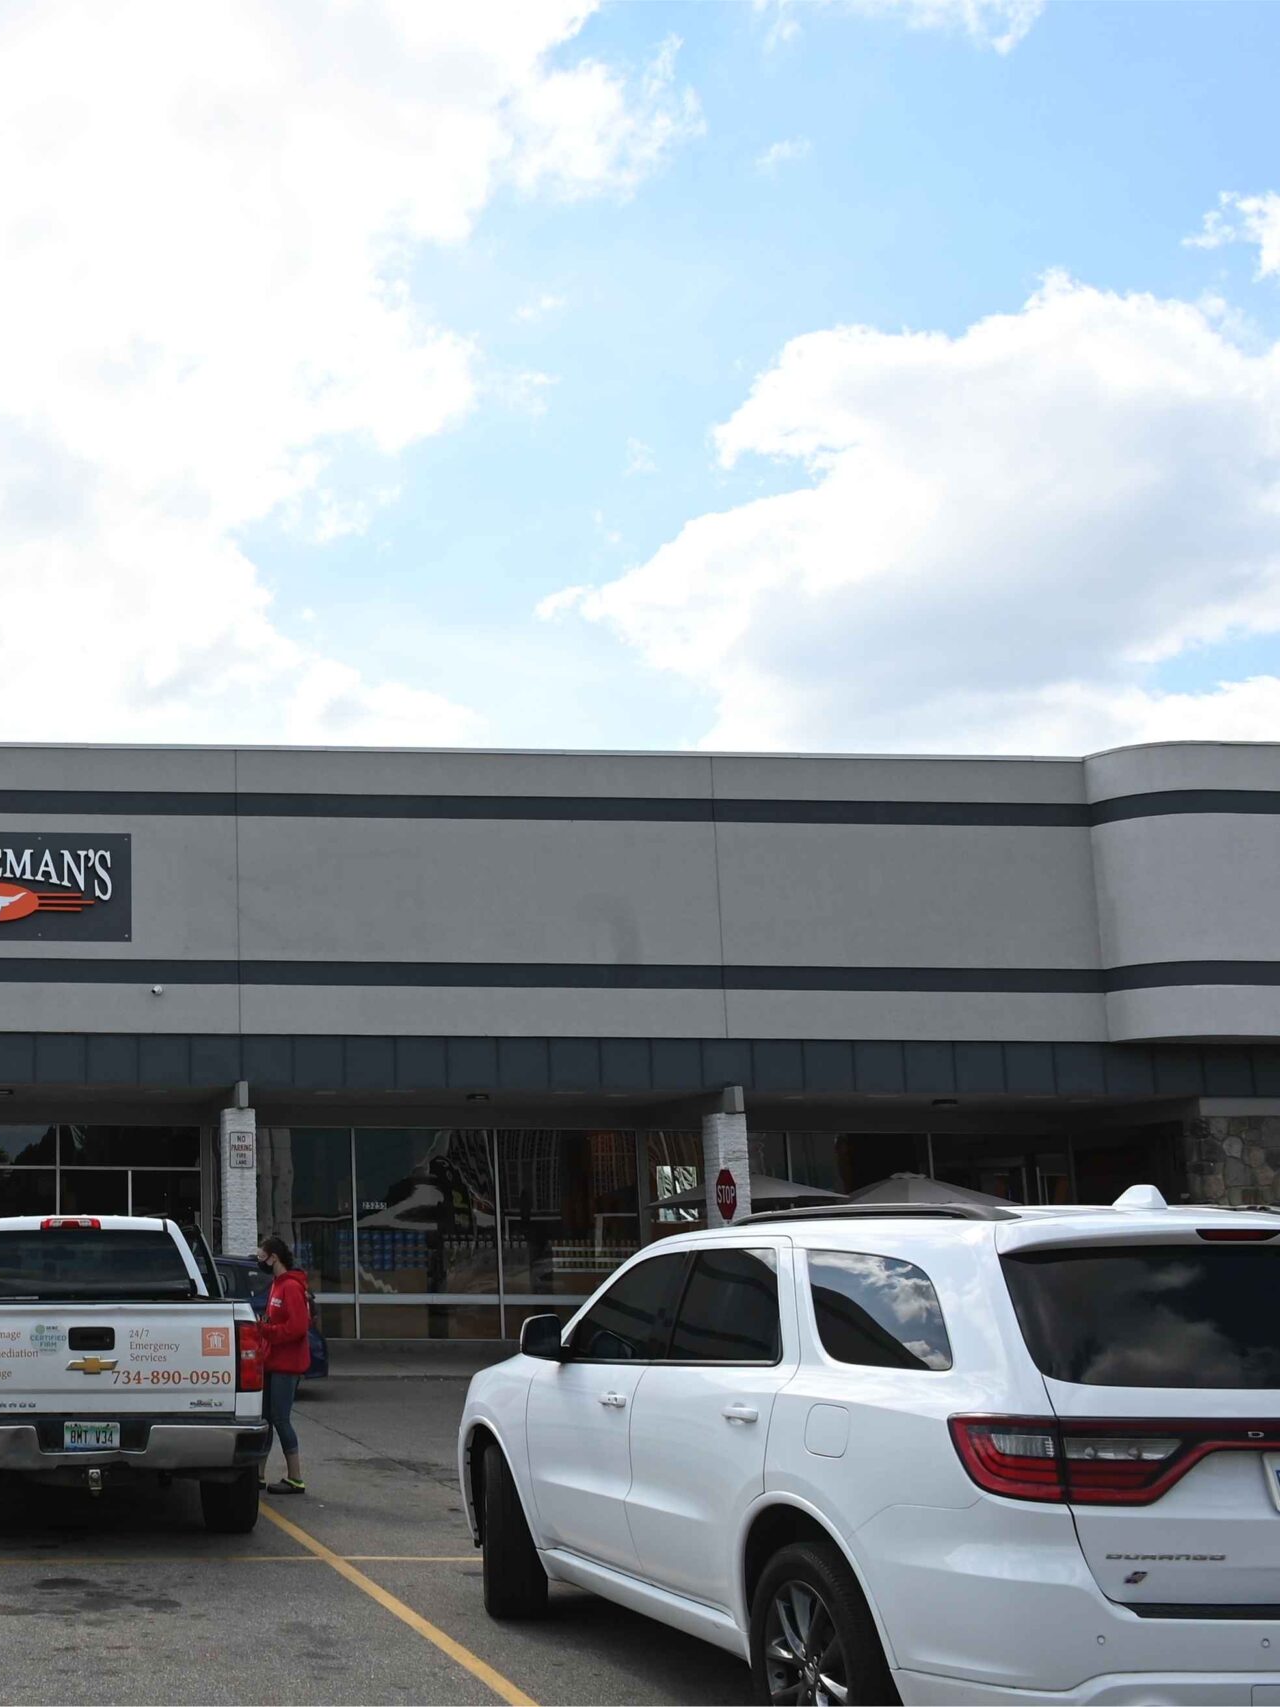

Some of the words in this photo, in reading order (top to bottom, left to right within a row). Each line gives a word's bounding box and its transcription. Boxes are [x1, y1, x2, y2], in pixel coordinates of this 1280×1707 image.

[236, 1135, 246, 1143] NO
[717, 1185, 736, 1204] STOP
[128, 1328, 151, 1340] 24/7
[129, 1341, 181, 1353] Emergency
[129, 1352, 168, 1362] Services
[111, 1370, 232, 1385] 734-890-0950
[95, 1429, 114, 1445] V34
